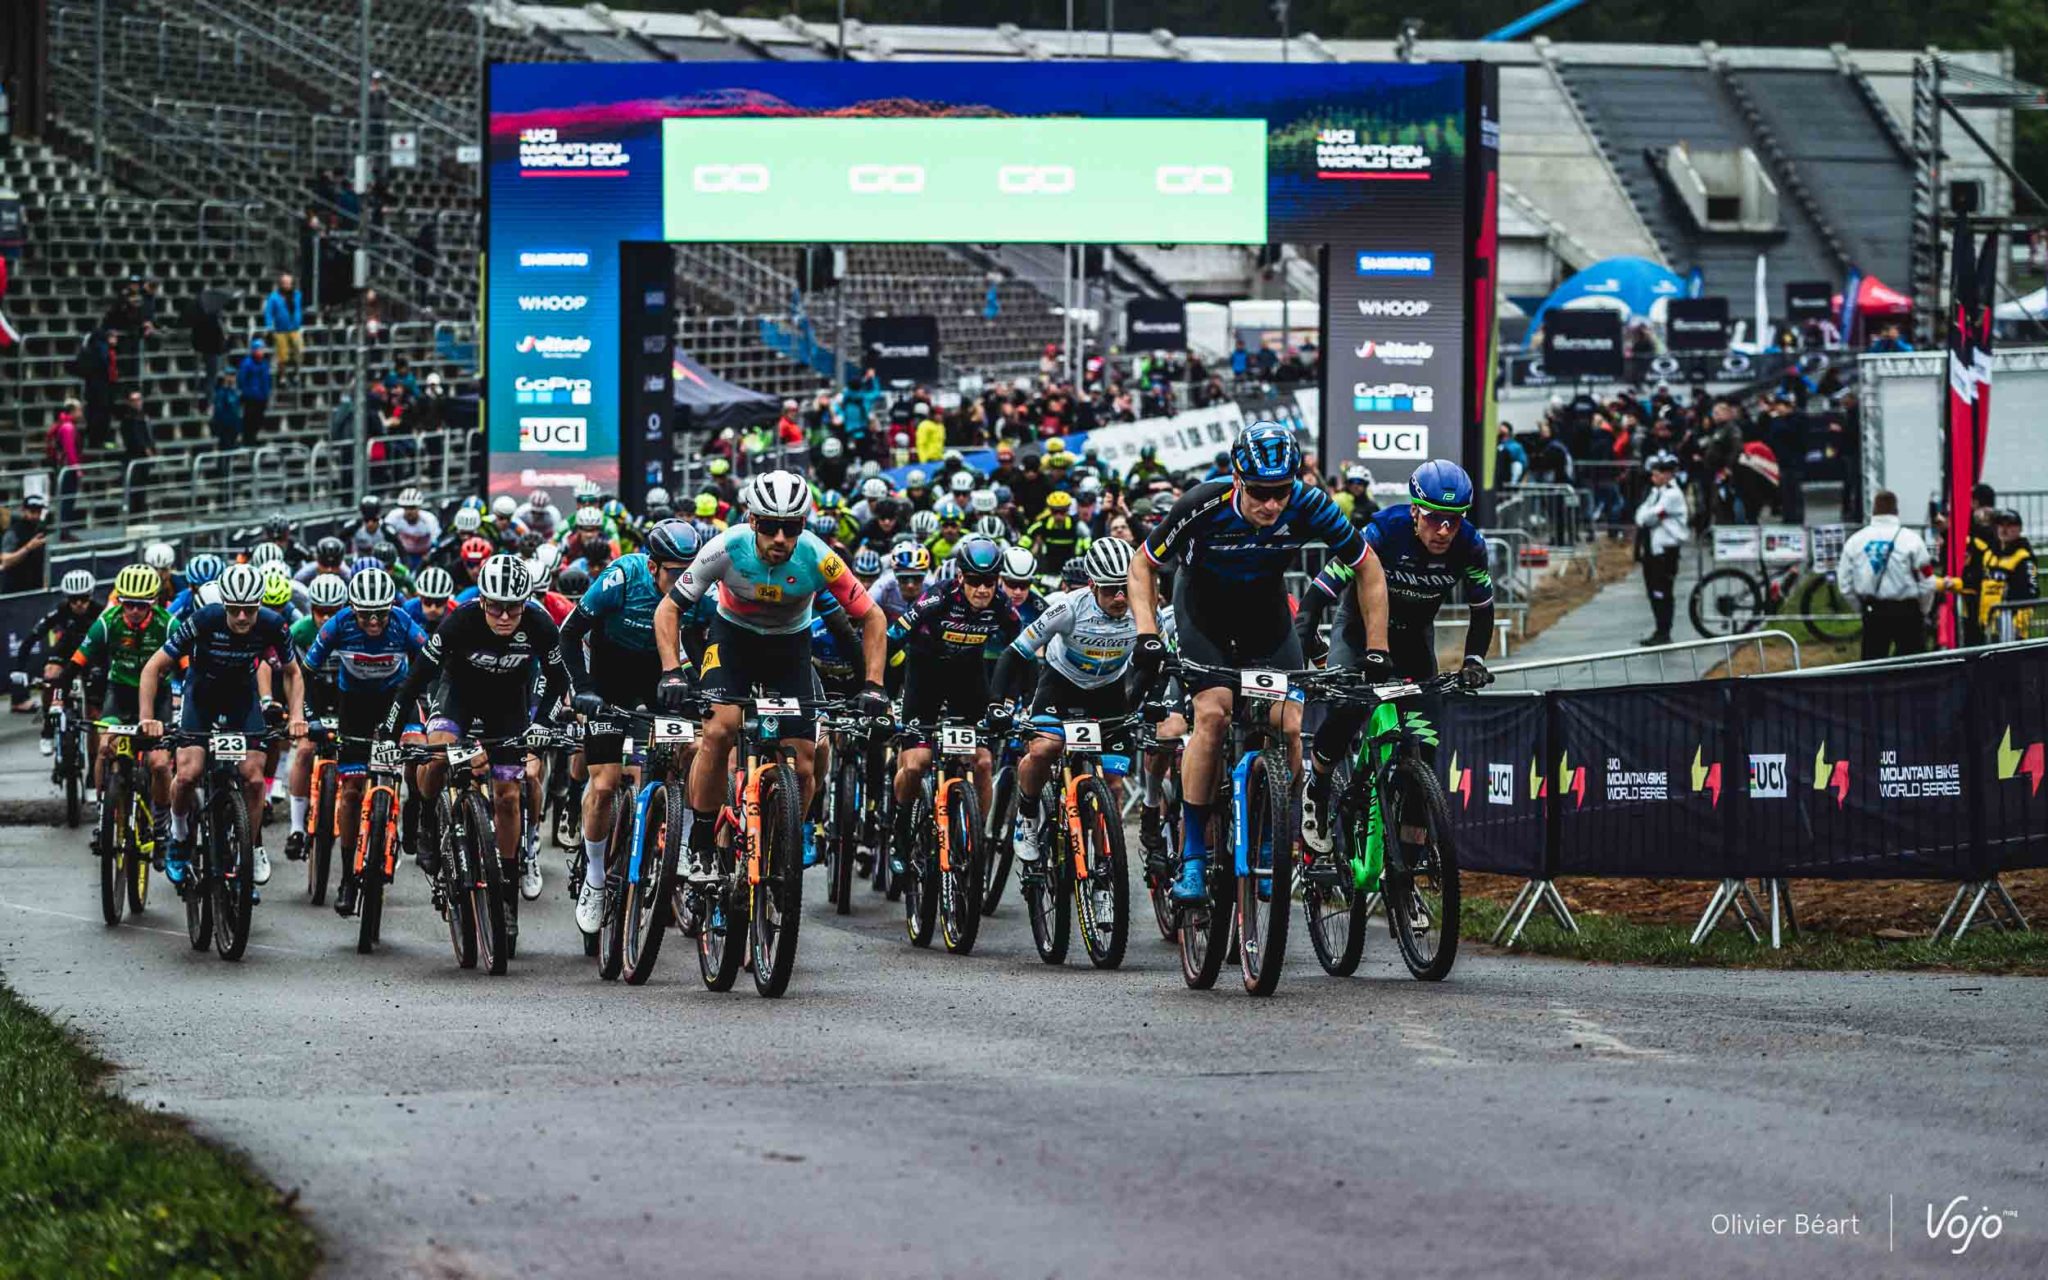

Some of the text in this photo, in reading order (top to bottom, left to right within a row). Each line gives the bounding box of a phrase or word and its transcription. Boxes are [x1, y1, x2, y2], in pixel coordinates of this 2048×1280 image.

[526, 129, 557, 143] UCI
[1324, 129, 1355, 143] UCI
[520, 143, 622, 155] MARATHON
[1317, 144, 1423, 156] MARATHON
[520, 154, 630, 167] WORLD CUP
[1317, 156, 1431, 169] WORLD CUP
[694, 165, 769, 193] GO
[849, 164, 924, 192] GO
[1000, 165, 1074, 193] GO
[1156, 165, 1232, 194] GO
[518, 295, 587, 311] WHOOP
[1358, 299, 1430, 316] WHOOP
[515, 376, 591, 391] GoPro
[1354, 382, 1433, 397] GoPro
[534, 425, 579, 443] UCI
[1373, 433, 1420, 450] UCI
[1165, 496, 1220, 547] BULLS
[1256, 674, 1273, 688] 6
[666, 723, 683, 735] 8
[1076, 726, 1091, 742] 2
[217, 738, 244, 751] 23
[947, 731, 973, 744] 15
[1609, 758, 1620, 770] UCI
[1882, 751, 1896, 765] UCI
[1757, 761, 1784, 791] UCI
[1880, 764, 1960, 780] MOUNTAIN BIKE
[1493, 770, 1511, 797] UCI
[1880, 781, 1960, 797] WORLD SERIES
[1607, 787, 1639, 800] WORLD
